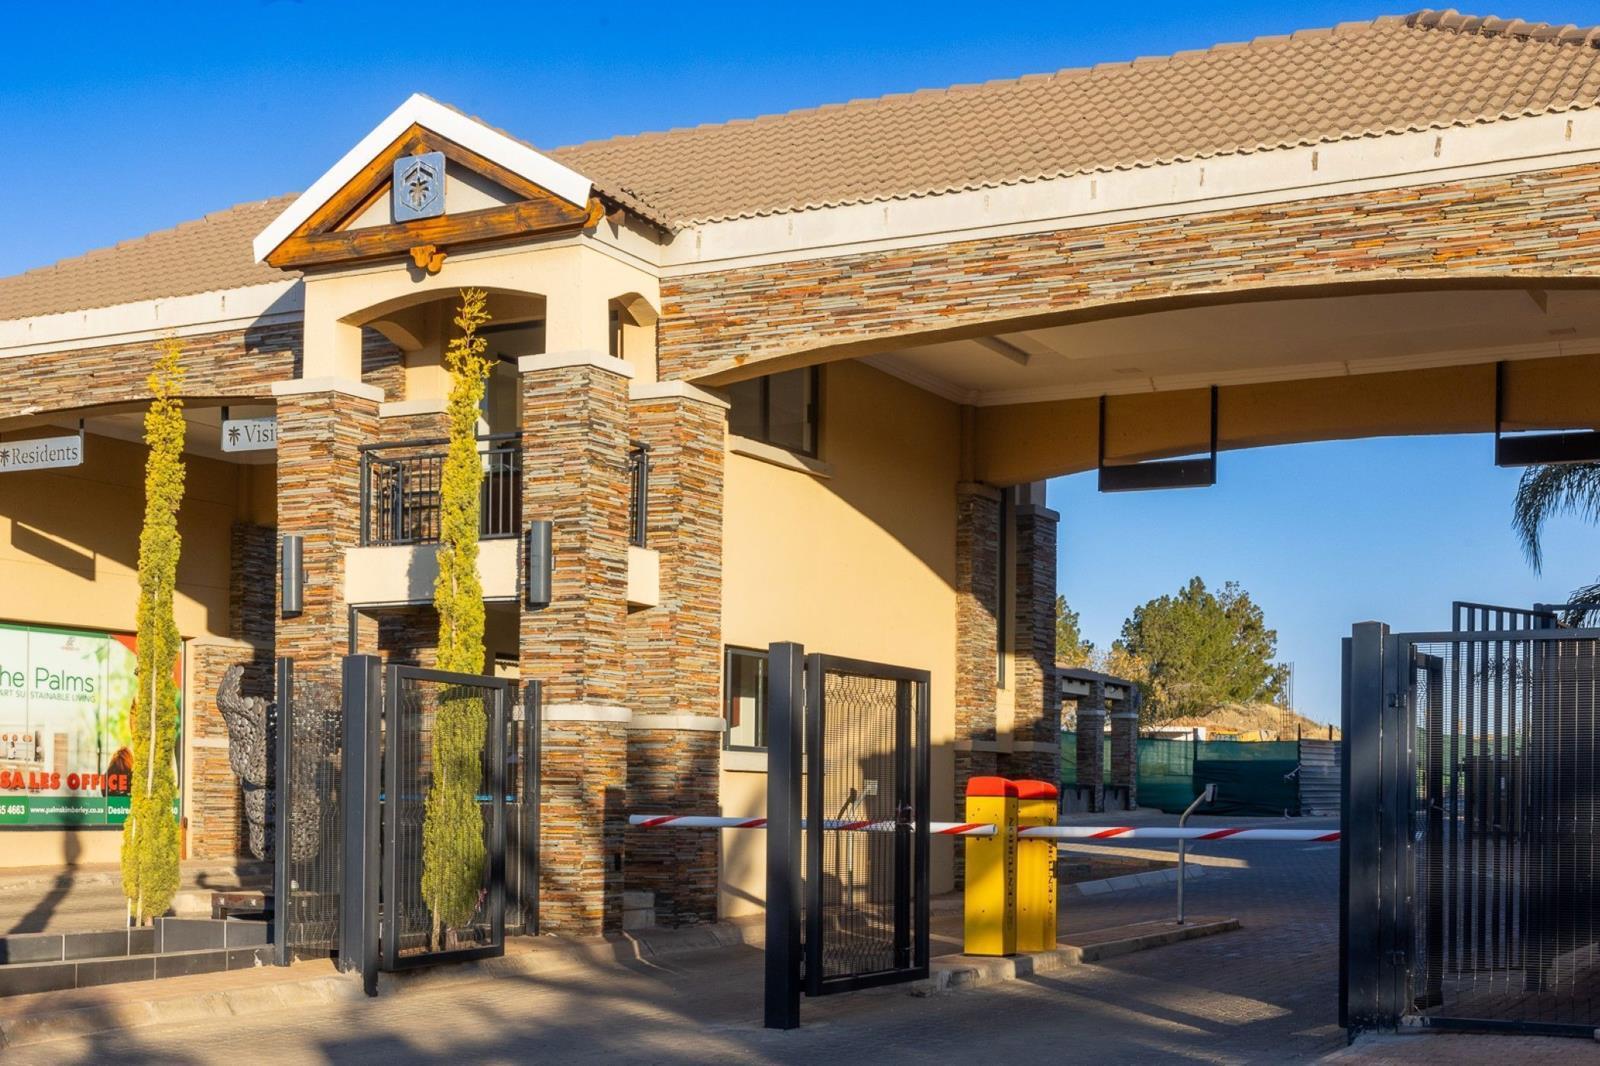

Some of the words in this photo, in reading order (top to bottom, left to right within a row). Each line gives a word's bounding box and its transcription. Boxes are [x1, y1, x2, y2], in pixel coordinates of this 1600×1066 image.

[11, 444, 78, 465] Residents
[35, 667, 94, 693] Palms
[66, 773, 128, 791] OFFICE
